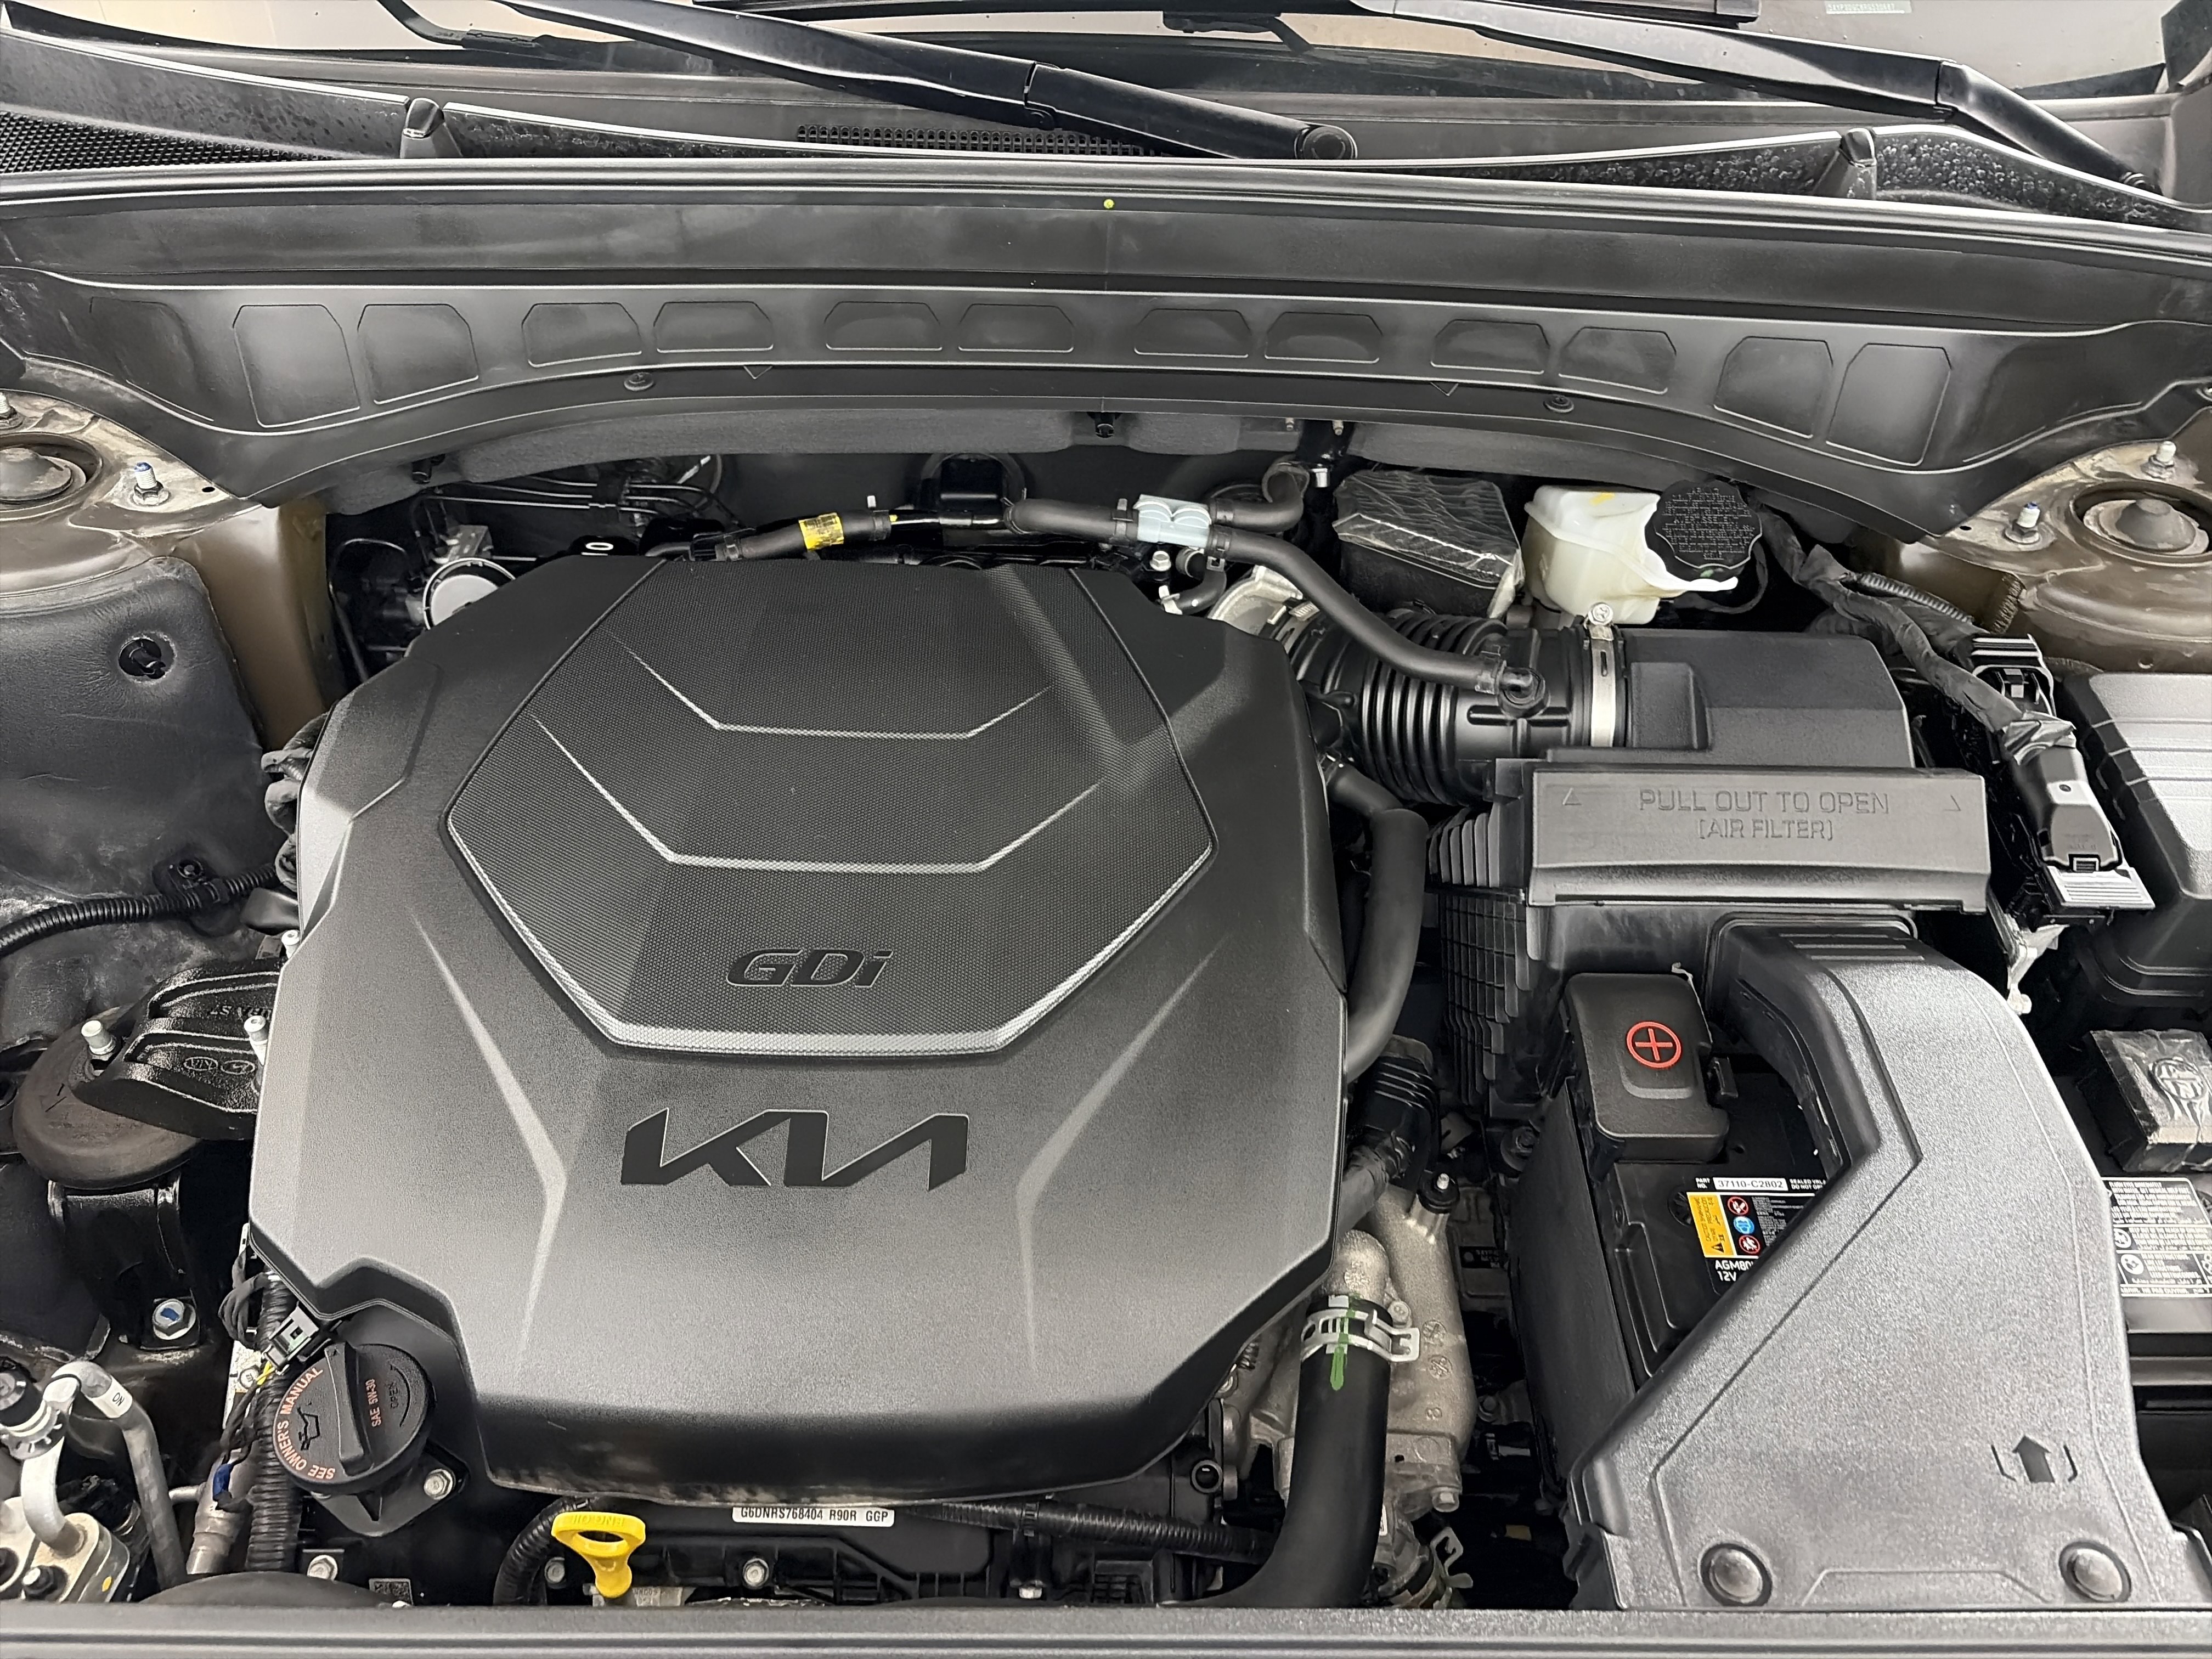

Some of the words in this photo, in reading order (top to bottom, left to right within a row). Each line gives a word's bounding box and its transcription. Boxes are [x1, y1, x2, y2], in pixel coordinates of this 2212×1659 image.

[1639, 788, 1707, 811] PULL
[1715, 790, 1768, 812] OUT
[1776, 791, 1810, 812] TO
[1819, 791, 1889, 814] OPEN
[726, 949, 894, 988] GDi
[621, 1107, 969, 1191] KIA
[1718, 1180, 1784, 1188] 37110-C2802
[1717, 1271, 1736, 1282] 12V
[280, 1367, 323, 1414] MANUAL
[365, 1378, 379, 1404] 5W-30
[370, 1407, 381, 1427] SAE
[278, 1420, 307, 1470] OWNER'S
[308, 1464, 336, 1480] SEE
[866, 1510, 888, 1522] GGP
